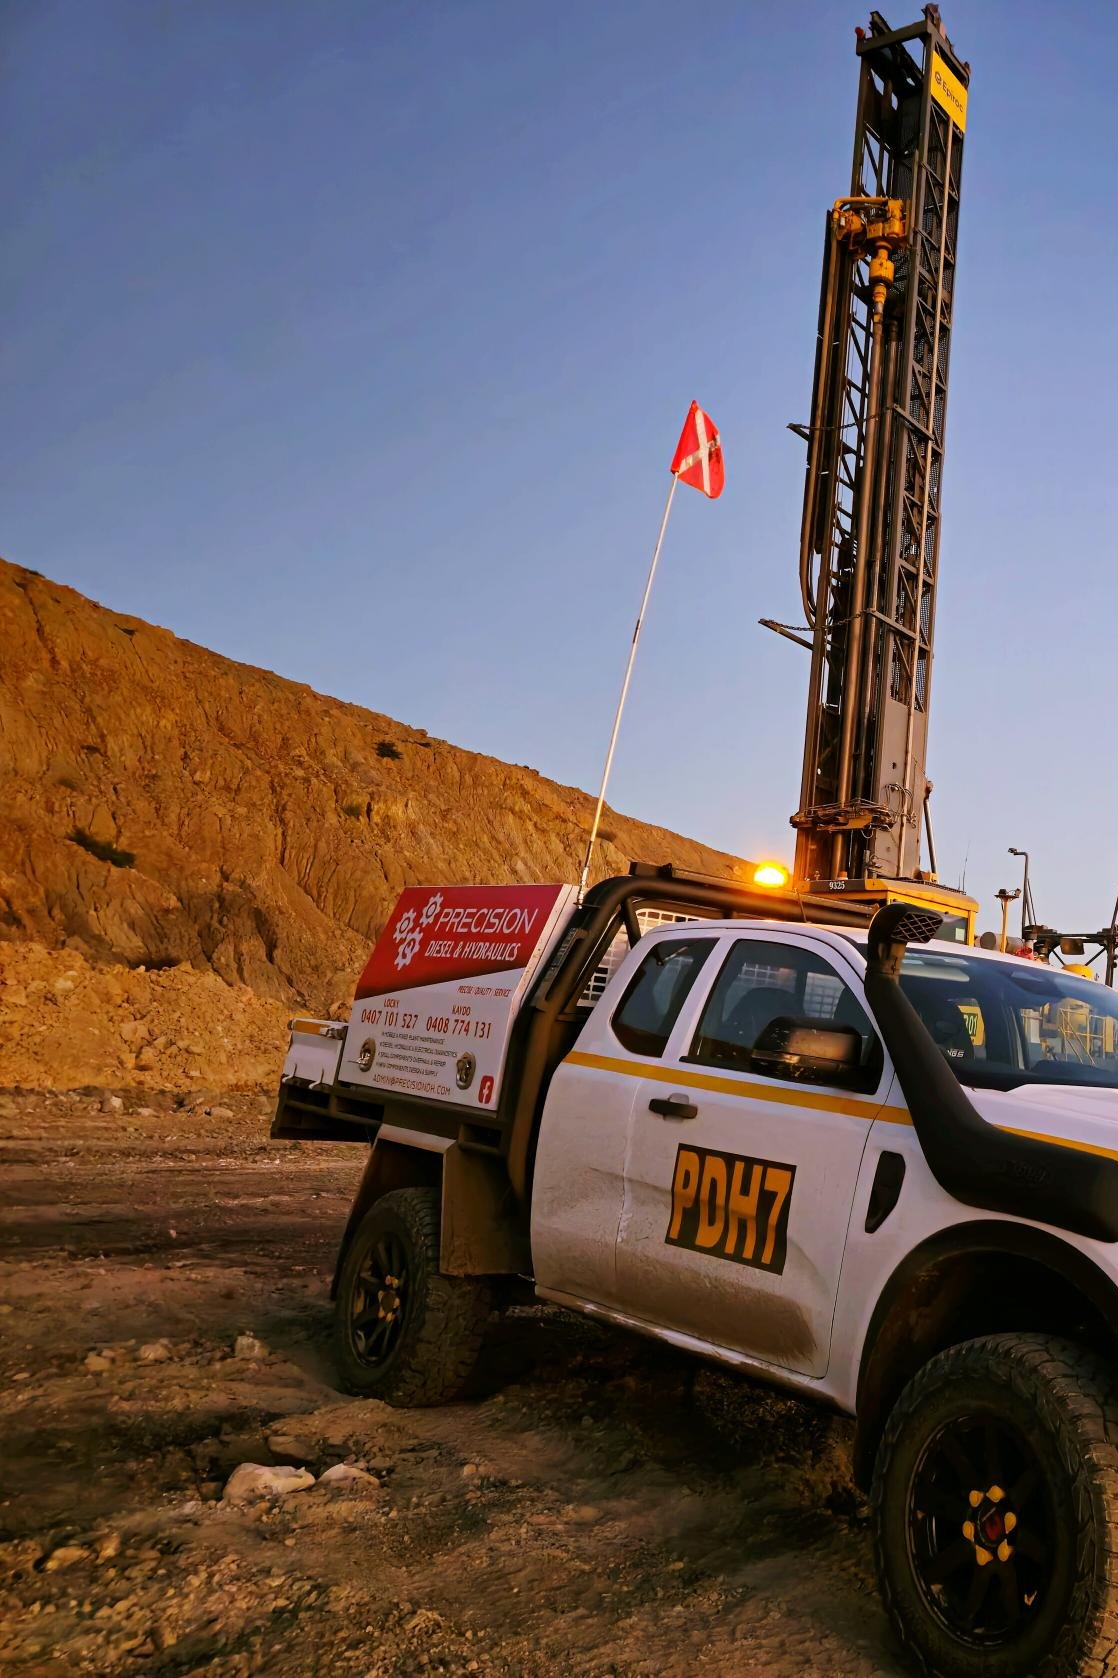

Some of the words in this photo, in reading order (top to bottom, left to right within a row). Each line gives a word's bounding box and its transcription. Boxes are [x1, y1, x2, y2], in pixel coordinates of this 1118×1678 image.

[434, 907, 540, 935] PRECISION
[424, 940, 455, 958] DIESEL
[453, 941, 464, 958] &
[461, 941, 521, 961] HYDRAULICS
[361, 1008, 382, 1025] 0407
[383, 1011, 399, 1027] 101
[401, 1013, 418, 1030] 527
[426, 1016, 450, 1034] 0408
[452, 1018, 471, 1036] 774
[473, 1021, 492, 1039] 131
[668, 1150, 792, 1265] PDH7
